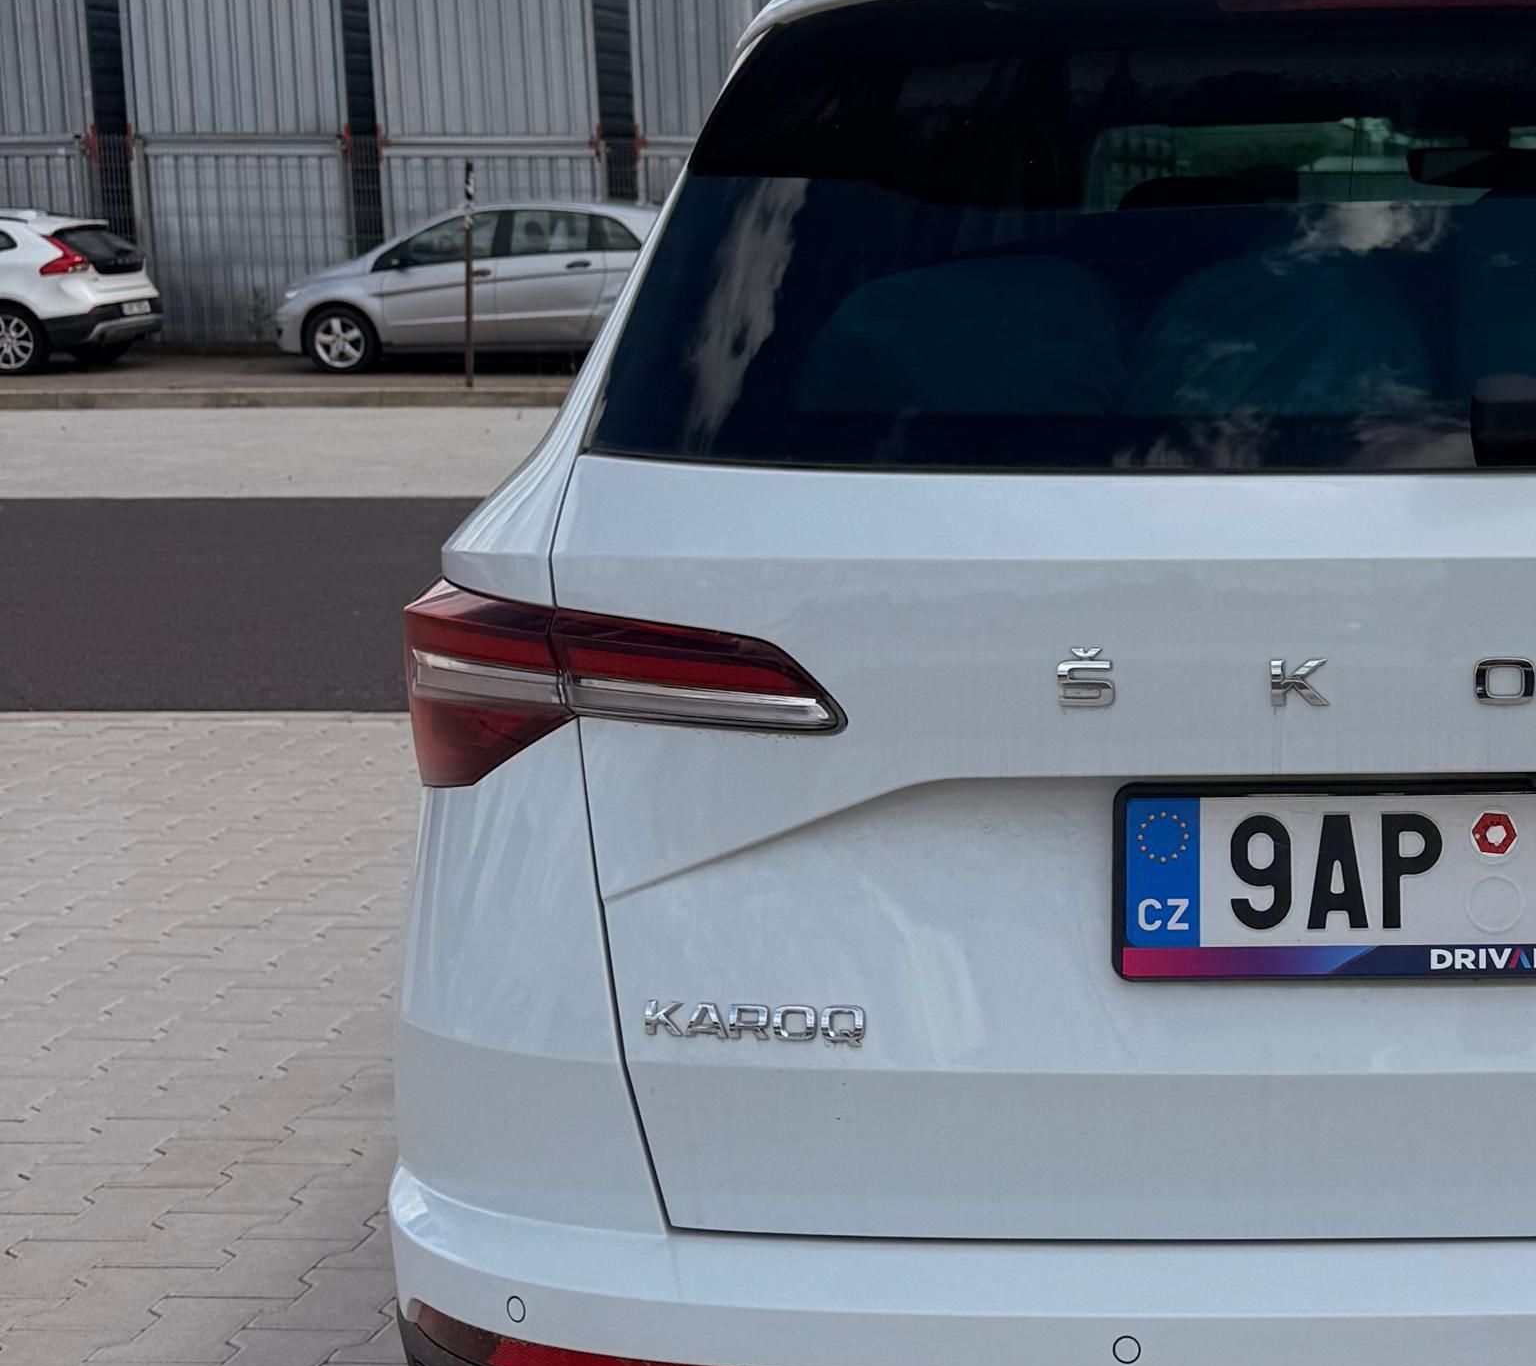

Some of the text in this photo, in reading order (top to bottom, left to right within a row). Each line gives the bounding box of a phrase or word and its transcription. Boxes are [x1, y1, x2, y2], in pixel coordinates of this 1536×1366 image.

[1230, 814, 1443, 930] 9AP
[1137, 898, 1190, 931] CZ
[644, 999, 866, 1047] KAROQ
